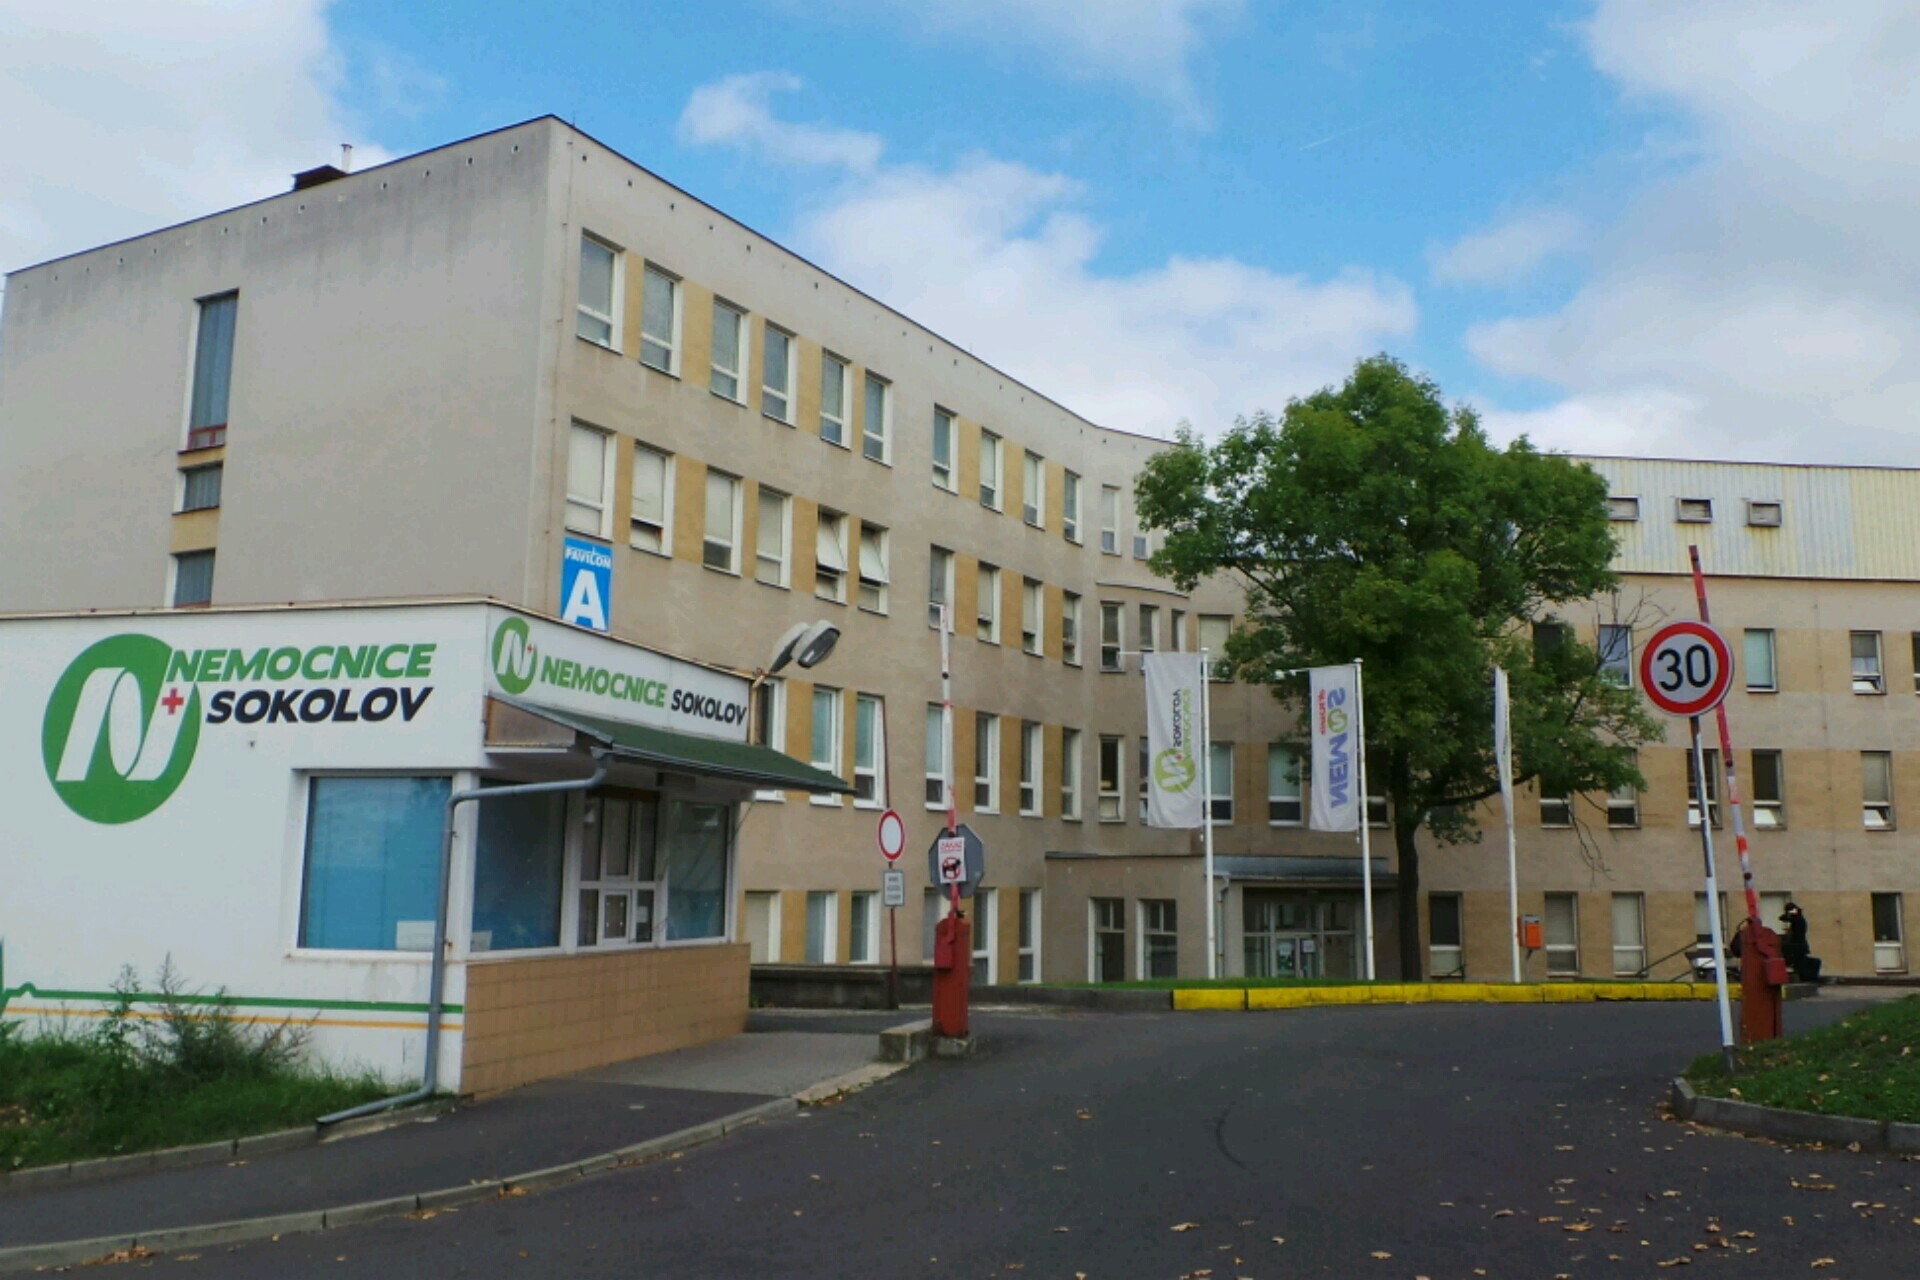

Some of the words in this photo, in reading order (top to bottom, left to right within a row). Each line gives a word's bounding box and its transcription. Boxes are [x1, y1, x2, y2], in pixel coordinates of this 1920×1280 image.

[562, 568, 608, 632] A
[166, 643, 437, 682] NEMOCNICE
[1657, 644, 1711, 692] 30
[206, 687, 434, 724] SOKOLOV
[540, 655, 668, 708] NEMOCNICE
[671, 689, 747, 726] SOKOLOV
